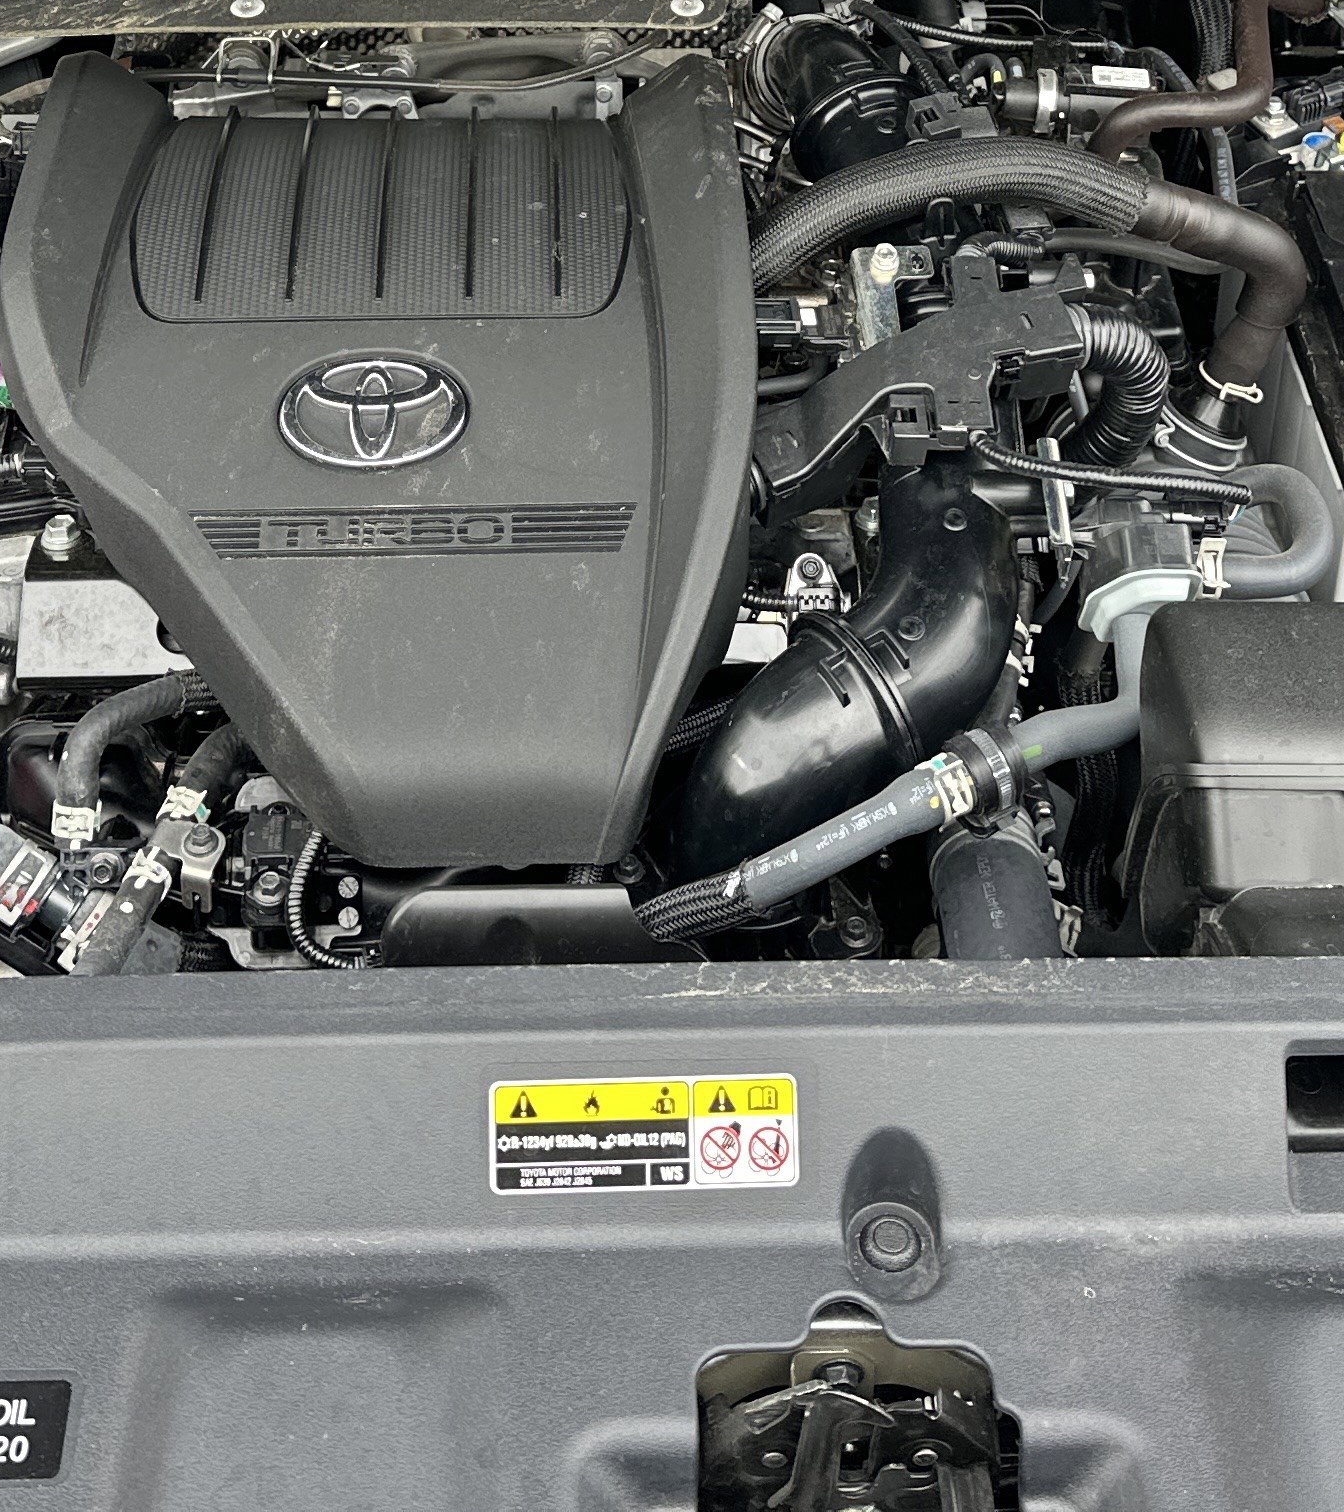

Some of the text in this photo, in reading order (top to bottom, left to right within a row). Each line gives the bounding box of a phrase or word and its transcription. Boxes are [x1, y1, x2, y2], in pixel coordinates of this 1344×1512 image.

[266, 514, 506, 548] TURBO
[519, 1166, 622, 1178] TOYOTA MOTOR CORPORATION
[659, 1165, 684, 1182] WS
